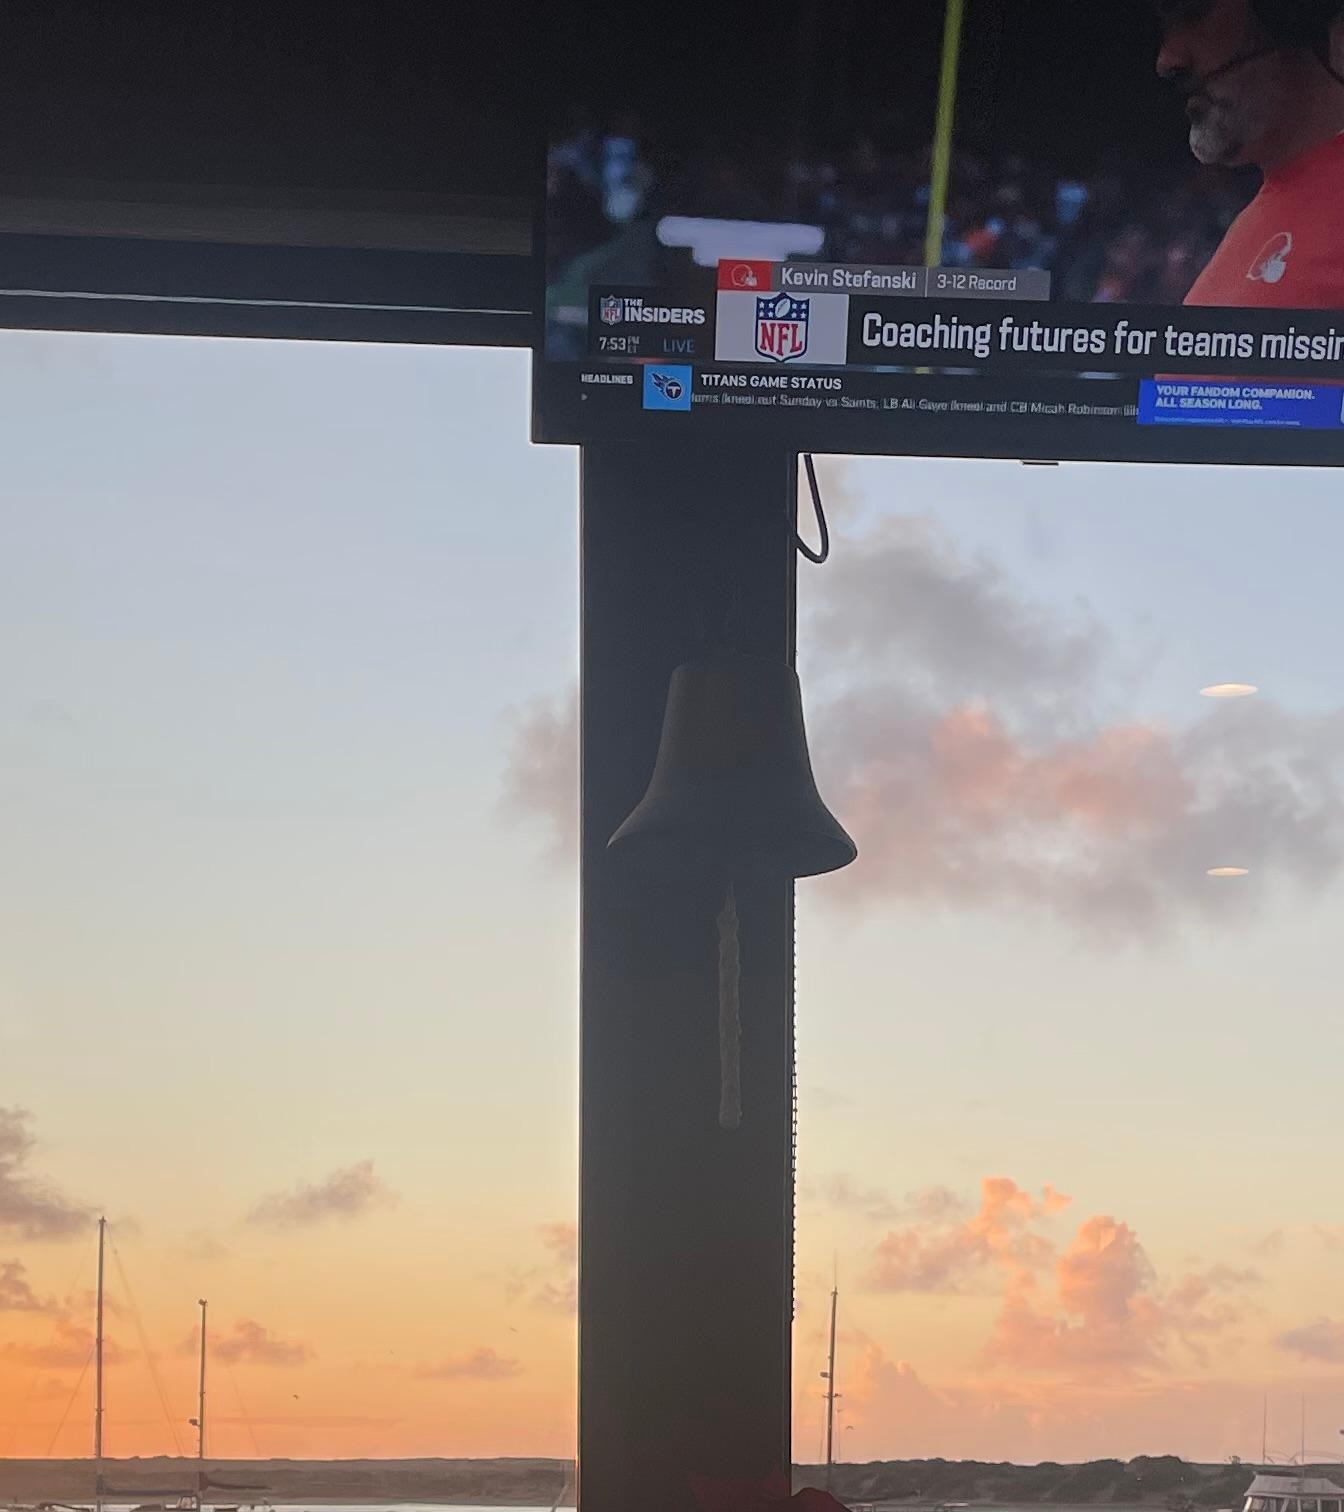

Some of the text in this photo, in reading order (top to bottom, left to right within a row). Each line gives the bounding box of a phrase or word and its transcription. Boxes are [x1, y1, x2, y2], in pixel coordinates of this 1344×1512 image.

[781, 267, 916, 290] Kevin Stefanski
[937, 274, 1017, 291] 3-12 Record
[624, 298, 643, 307] THE
[624, 307, 706, 325] INSIDERS
[759, 321, 804, 357] NFL
[862, 312, 992, 358] Coaching
[999, 317, 1106, 353] futures
[1113, 320, 1157, 355] for
[1164, 325, 1254, 358] teams
[599, 336, 626, 351] 7:53
[663, 338, 695, 353] LIVE
[581, 374, 633, 385] HEADLINES
[701, 374, 842, 390] TITANS GAME STATUS
[1156, 385, 1316, 400] YOUR FANDOM COMPANION.
[780, 394, 822, 409] Sunday
[1156, 397, 1263, 411] ALL SEASON LONG.
